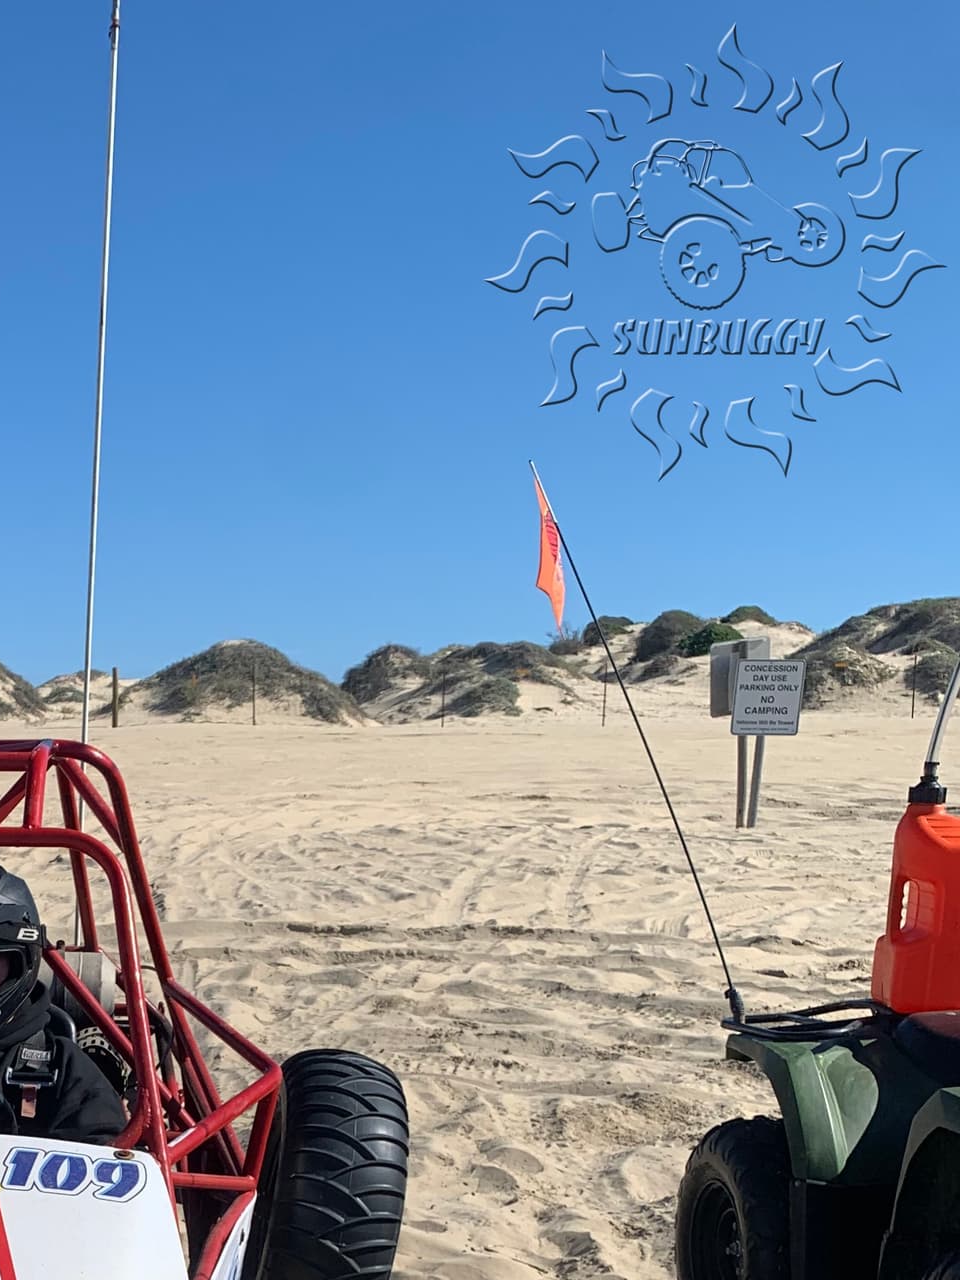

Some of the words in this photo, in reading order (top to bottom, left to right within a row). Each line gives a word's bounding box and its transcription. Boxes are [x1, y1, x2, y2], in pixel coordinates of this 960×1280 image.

[744, 664, 798, 672] CONCESSION
[752, 674, 769, 682] DAY
[771, 674, 787, 682] USE
[739, 684, 775, 692] PARKING
[777, 684, 799, 692] ONLY
[760, 696, 775, 704] NO
[744, 707, 788, 715] CAMPING
[3, 1147, 145, 1199] 109
